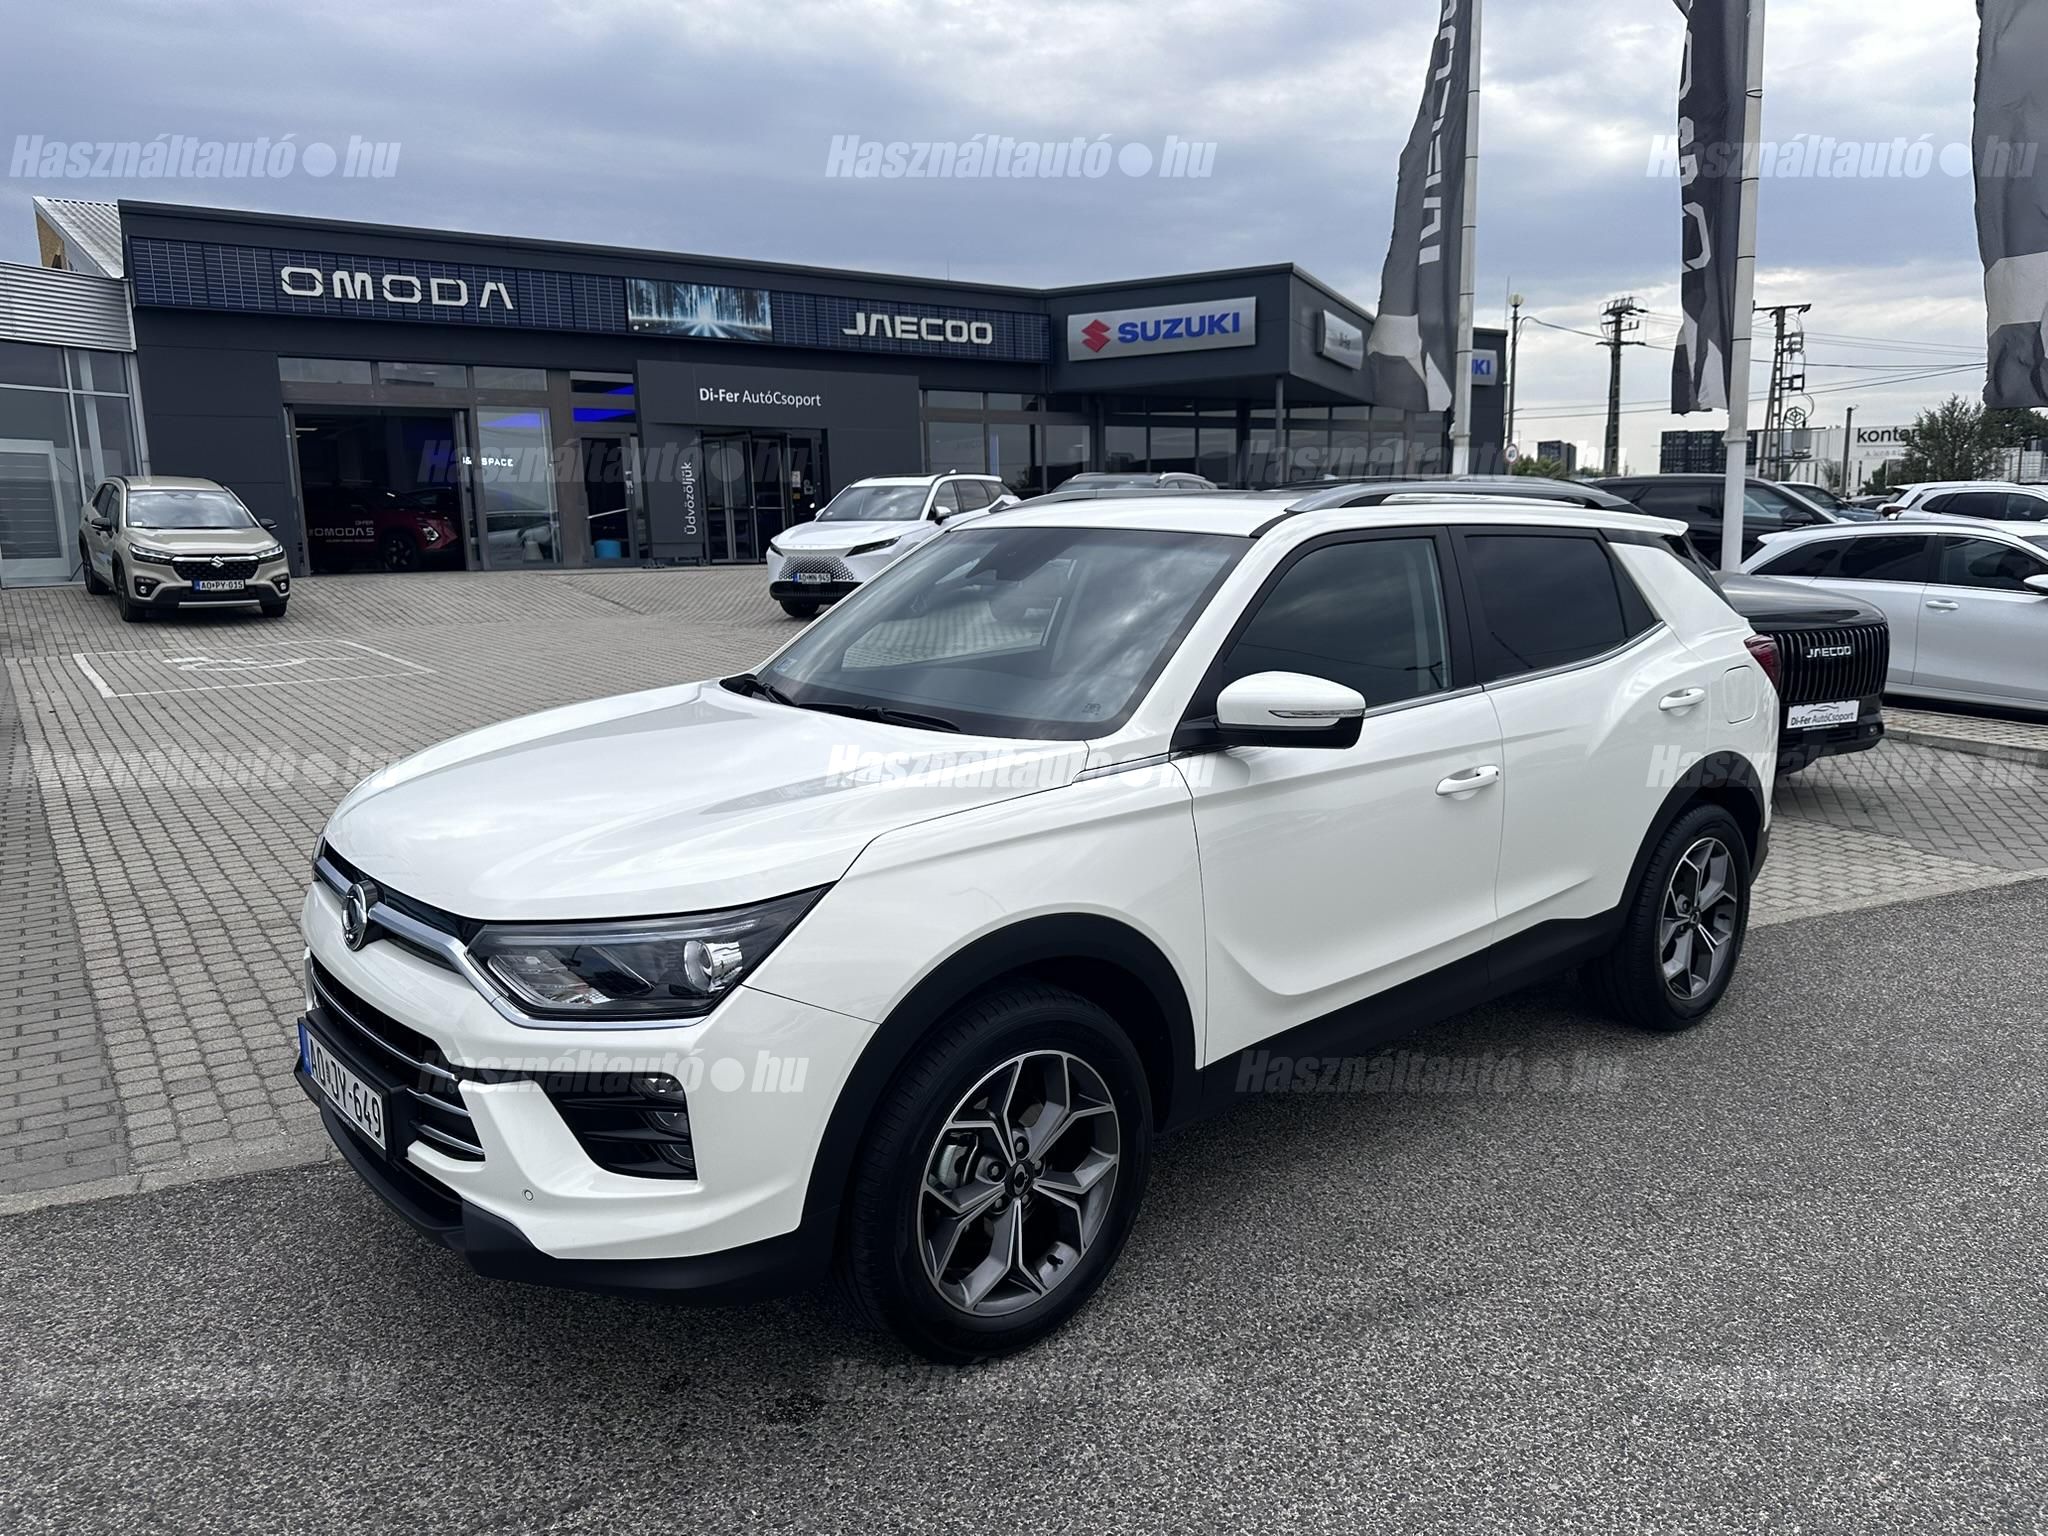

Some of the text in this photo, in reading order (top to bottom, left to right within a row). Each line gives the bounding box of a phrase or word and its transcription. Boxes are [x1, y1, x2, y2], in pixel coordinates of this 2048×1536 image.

[281, 266, 513, 309] OMODA
[842, 312, 992, 344] JAECOO
[1118, 312, 1240, 343] SUZUKI
[700, 387, 821, 408] Di-Fer AutóCsoport
[481, 457, 513, 467] SPACE
[681, 462, 697, 535] Üdvözöljük
[1806, 646, 1851, 658] JAECOO
